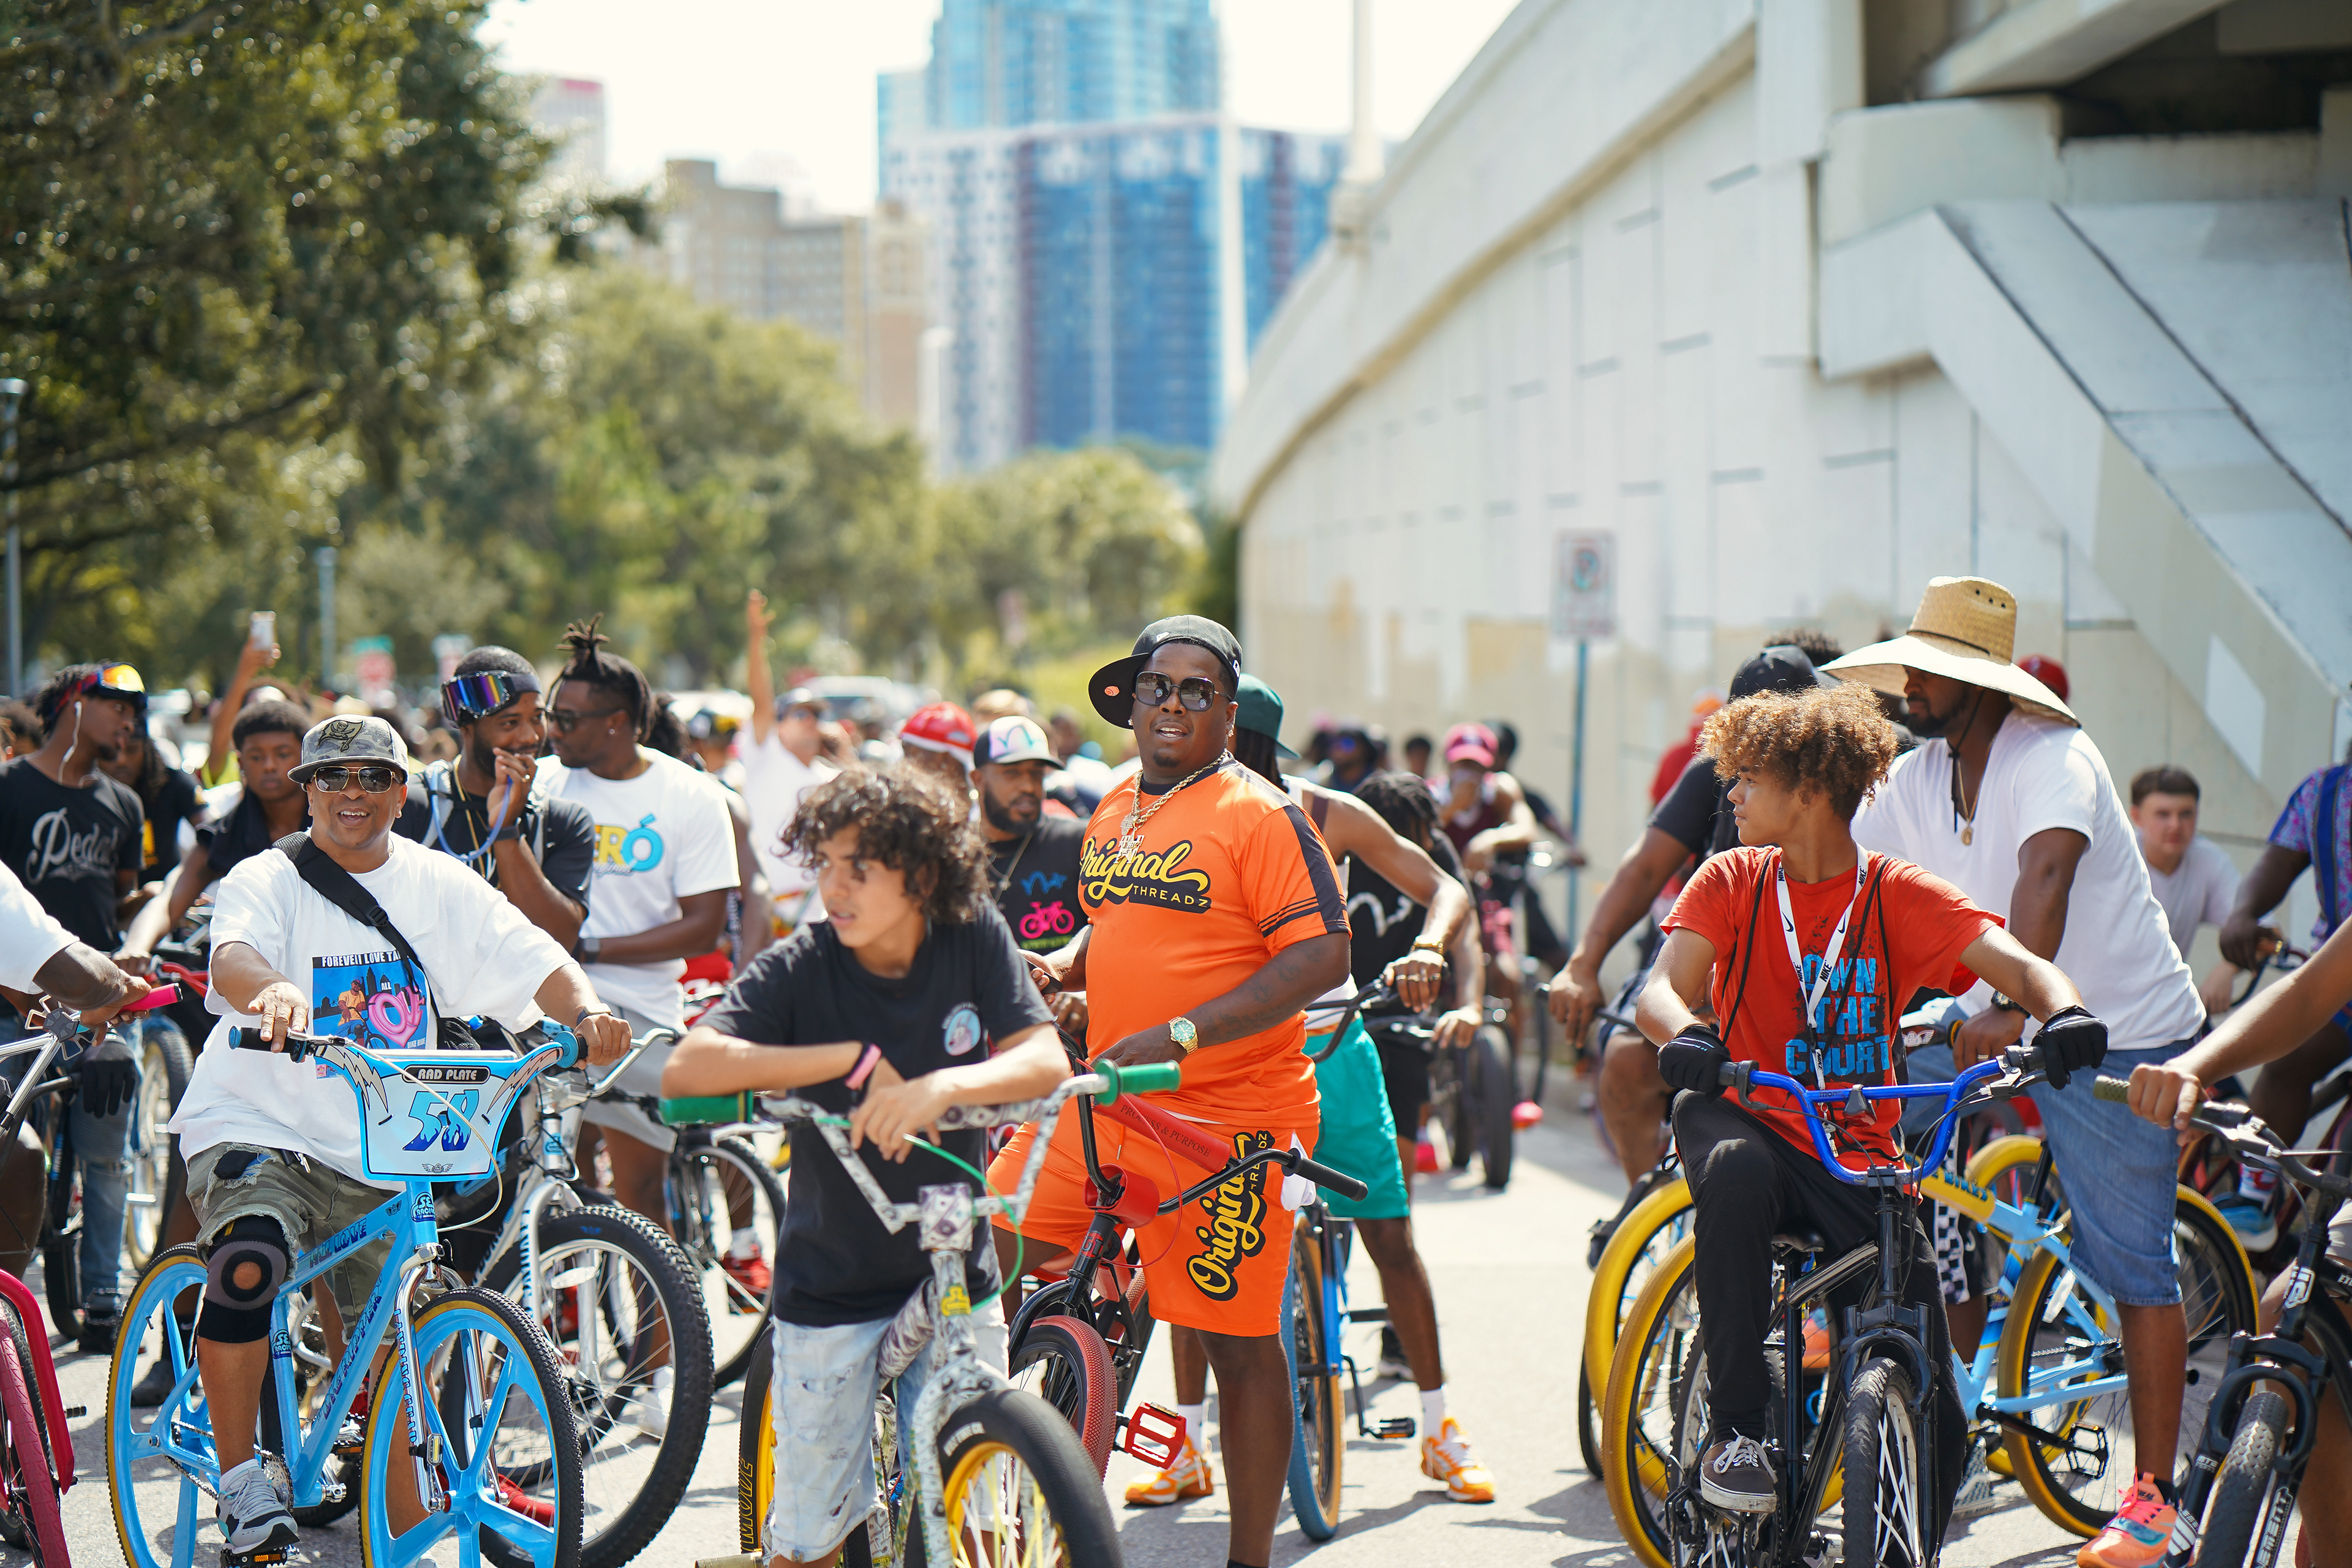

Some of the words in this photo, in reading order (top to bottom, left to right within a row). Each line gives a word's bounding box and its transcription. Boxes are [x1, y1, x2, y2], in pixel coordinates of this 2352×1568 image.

[1858, 867, 1867, 887] NIKE
[1133, 885, 1208, 908] THREADZ
[364, 951, 386, 965] LOVE
[1794, 963, 1804, 982] NIKE
[1803, 954, 1876, 993] OWN
[1819, 962, 1833, 982] NIKE
[381, 982, 392, 990] ALL
[1814, 996, 1877, 1035] THE
[1785, 1034, 1890, 1076] COURT
[418, 1068, 443, 1080] RAD
[446, 1069, 477, 1080] PLATE
[402, 1089, 480, 1152] 58
[1161, 1126, 1169, 1136] &
[1169, 1130, 1211, 1157] PURPOSE
[418, 1196, 434, 1208] SE
[334, 1218, 367, 1253] LOVE
[1082, 1235, 1104, 1256] GT
[276, 1333, 290, 1345] SE
